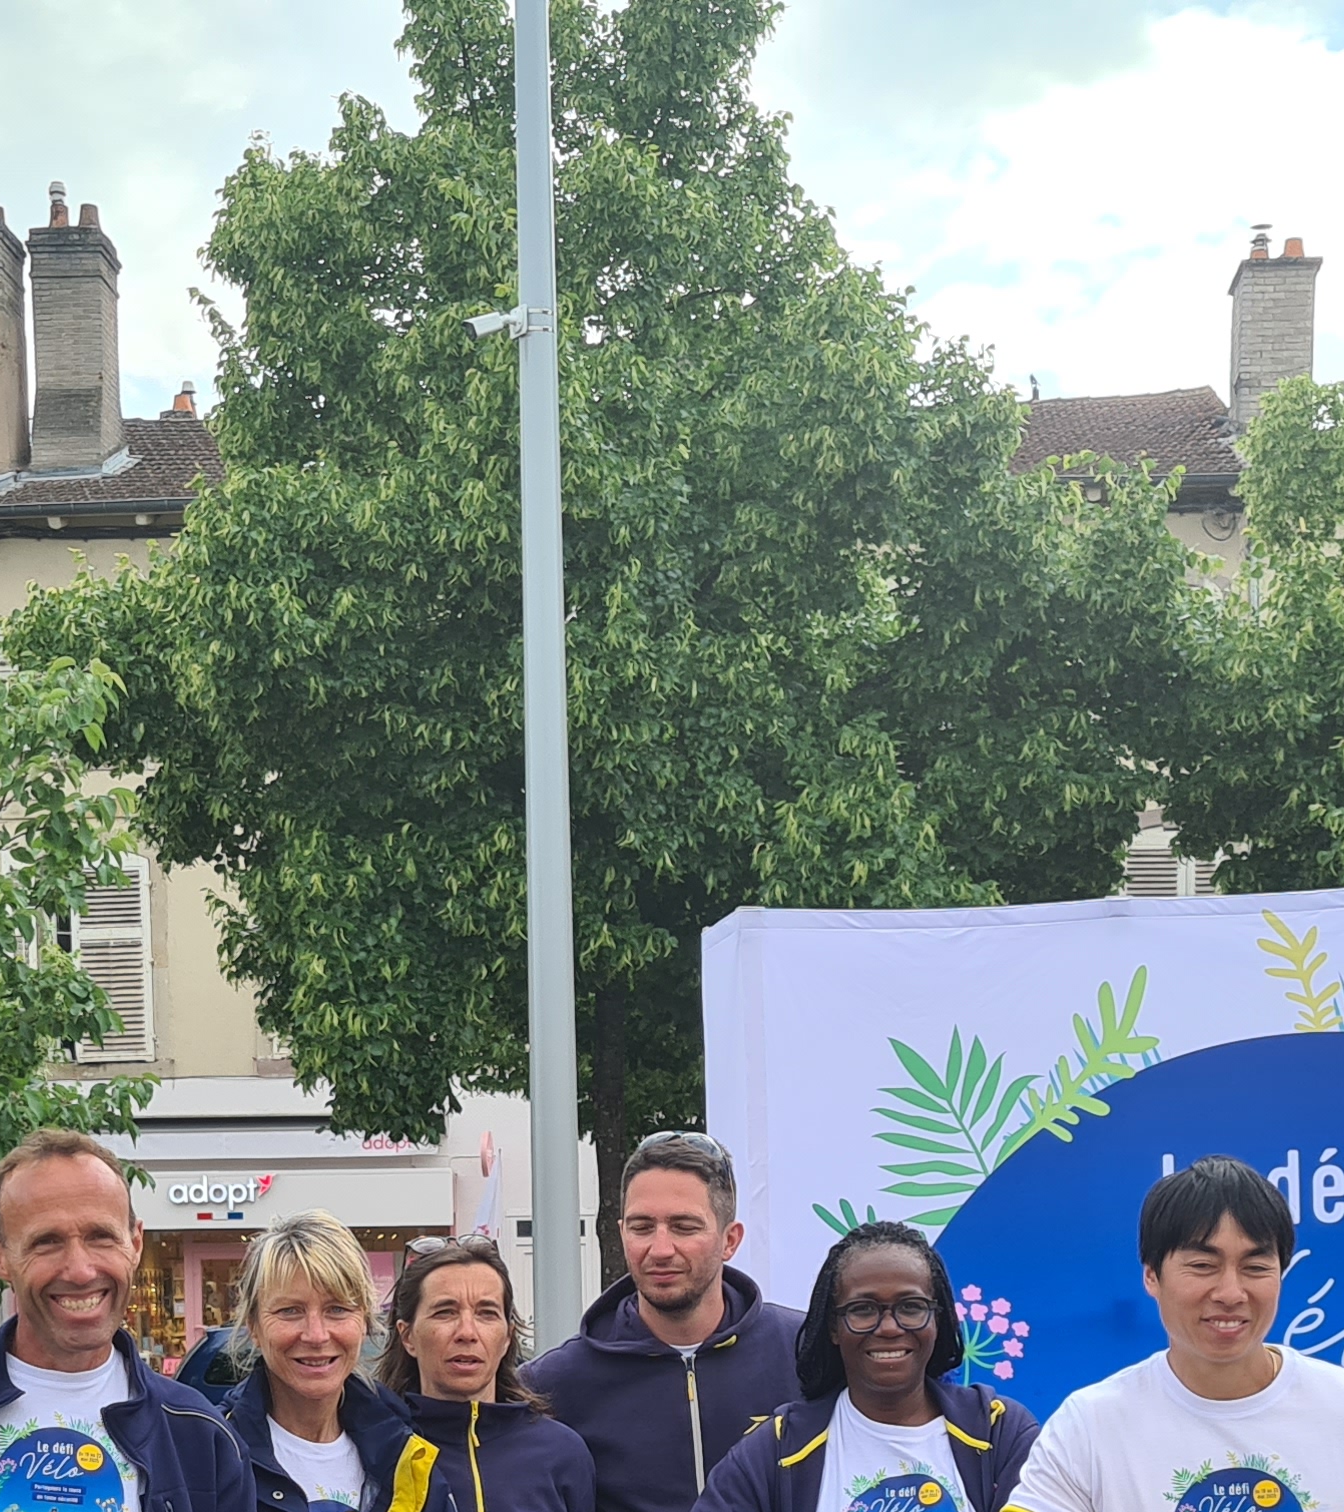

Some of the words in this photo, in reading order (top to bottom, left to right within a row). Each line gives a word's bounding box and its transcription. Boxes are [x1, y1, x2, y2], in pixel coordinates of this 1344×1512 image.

[362, 1134, 412, 1153] adop
[168, 1175, 258, 1210] adopt
[37, 1441, 49, 1453] Le
[53, 1442, 74, 1455] défi
[20, 1452, 84, 1480] Vélo
[885, 1488, 895, 1497] Le
[899, 1486, 916, 1497] défi
[1214, 1484, 1224, 1496] Le
[1229, 1483, 1250, 1495] défi
